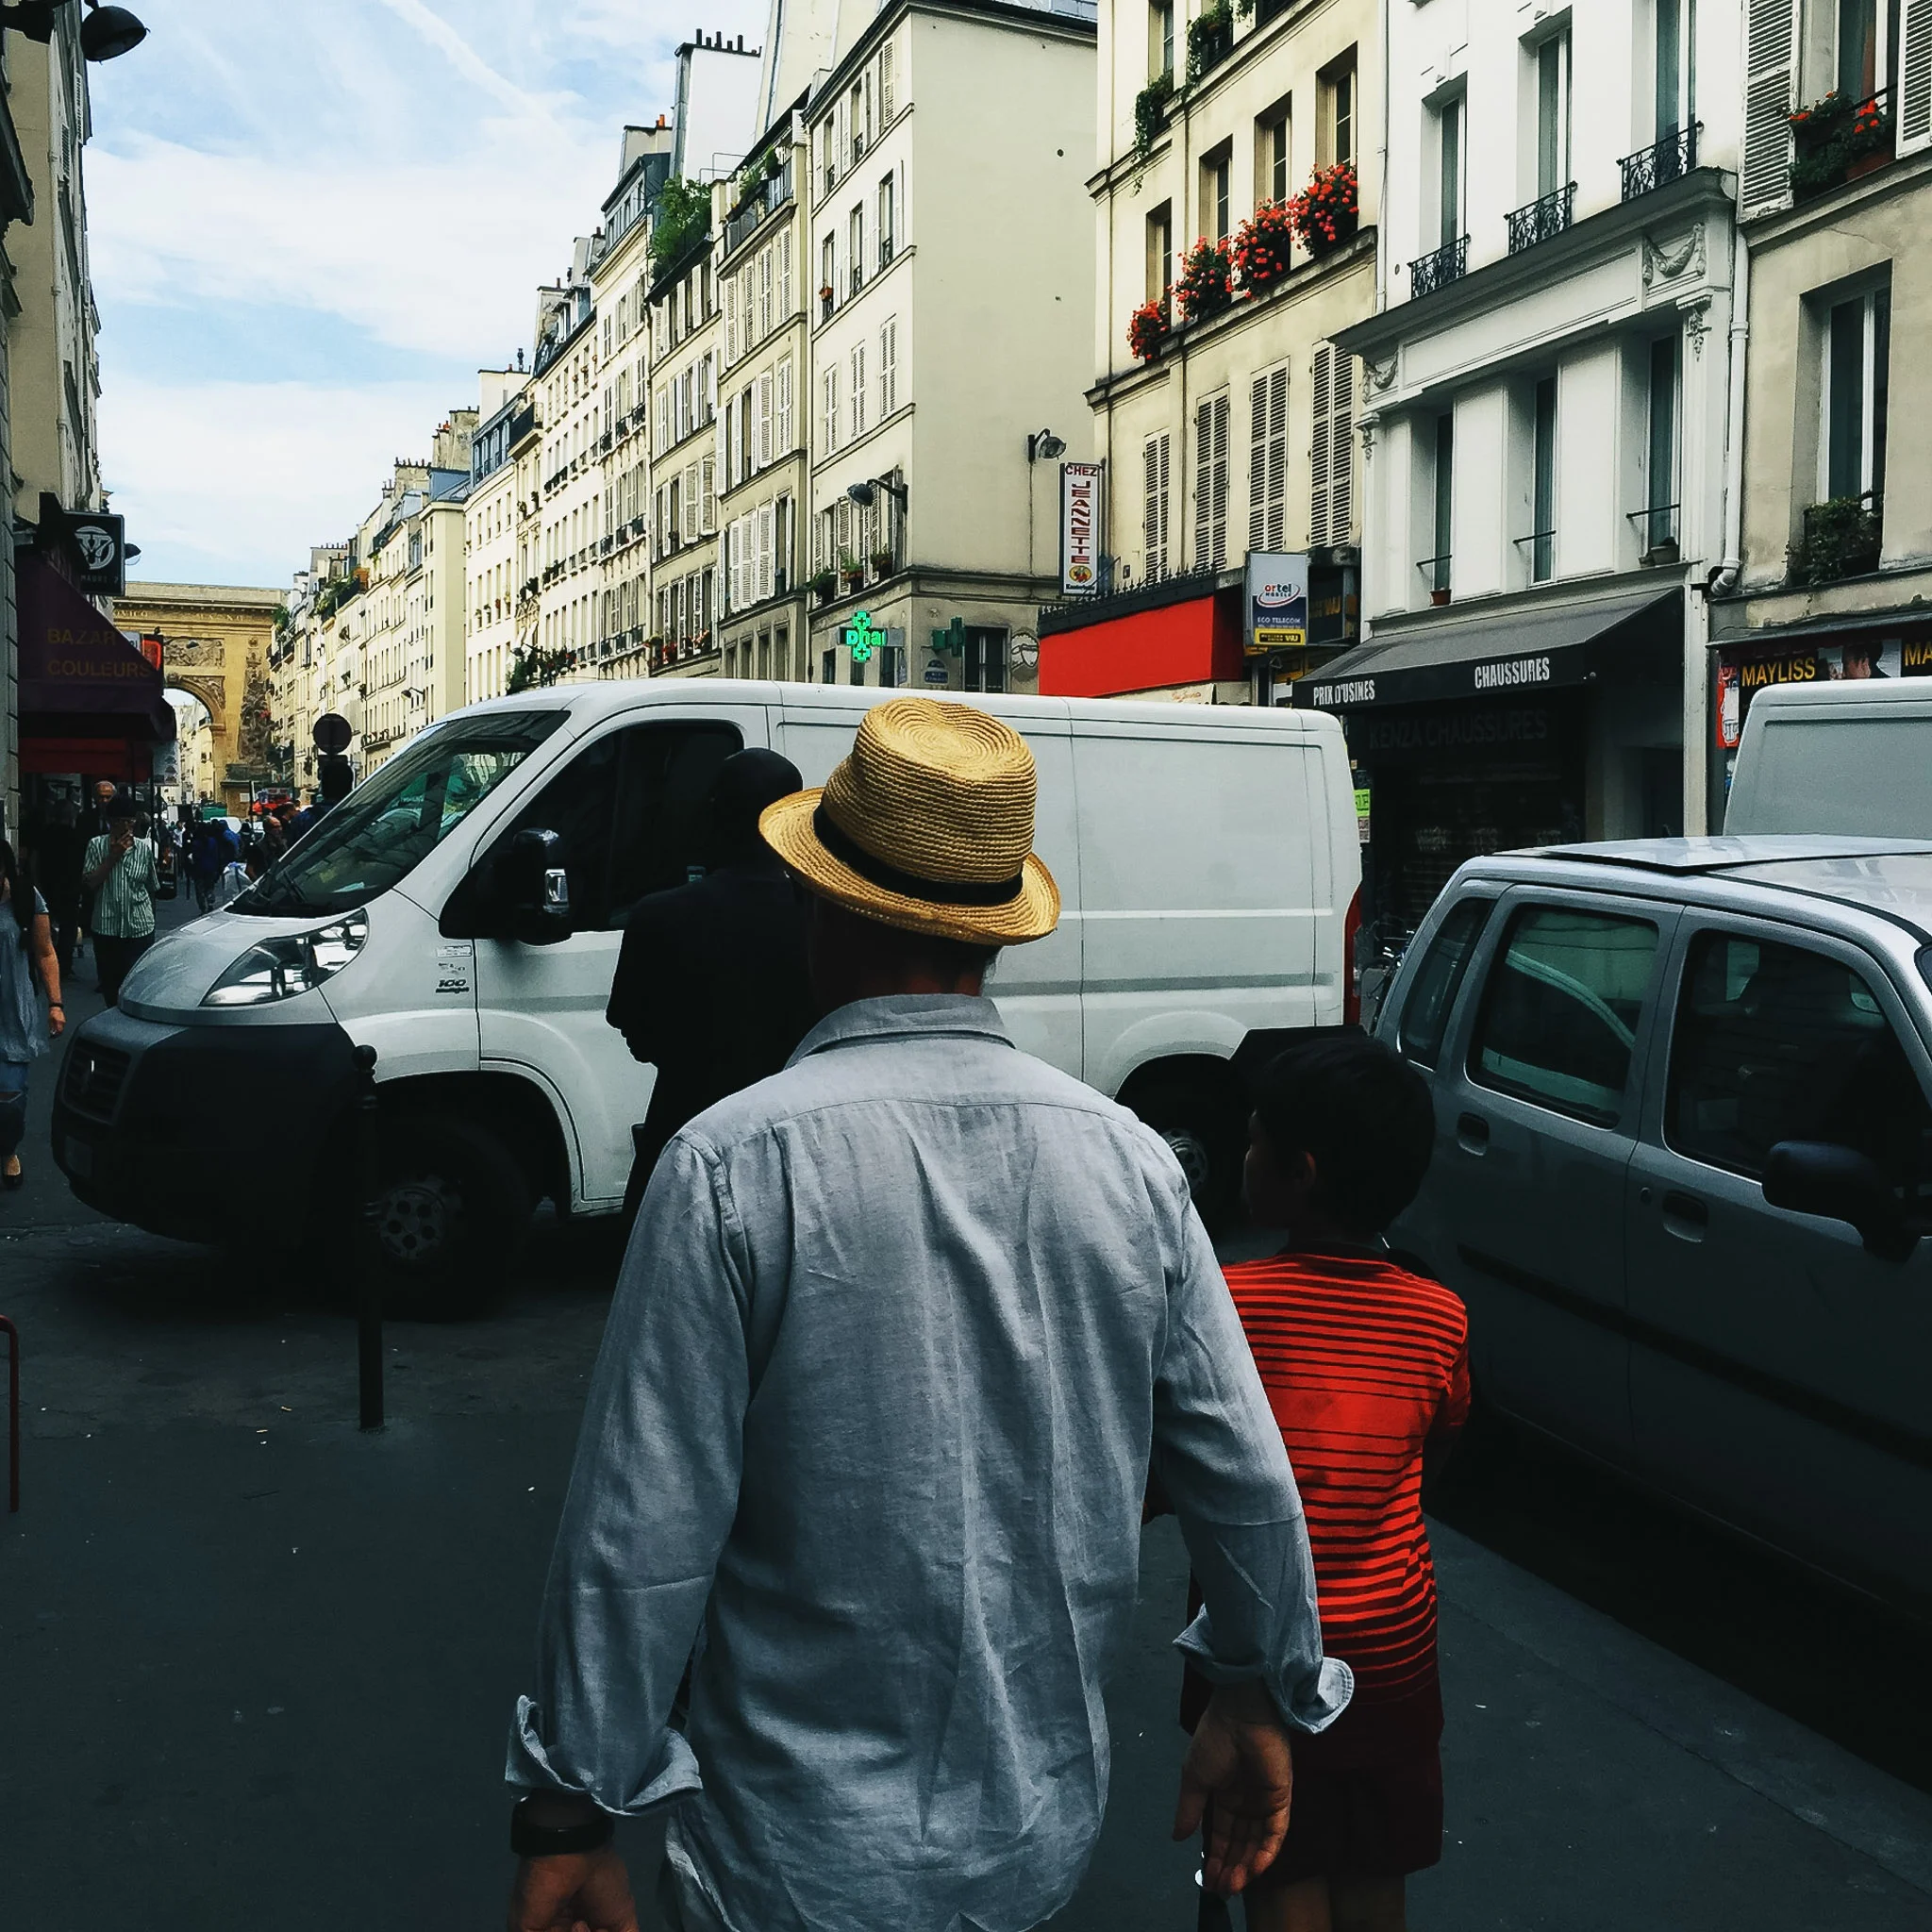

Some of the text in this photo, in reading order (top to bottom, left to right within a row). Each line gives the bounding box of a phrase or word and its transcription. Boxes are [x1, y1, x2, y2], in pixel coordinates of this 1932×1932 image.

[1066, 464, 1097, 476] CHEZ
[1071, 480, 1091, 564] JEANNETTE
[47, 629, 116, 646] BAZAR
[47, 660, 152, 678] COULEURS
[1474, 658, 1550, 690] CHAUSSURES
[1741, 658, 1816, 687] MAYLISS
[1313, 679, 1375, 707] PRIX D'USINES
[1369, 709, 1548, 750] KENZA CHAUSSURES
[439, 978, 466, 988] 100
